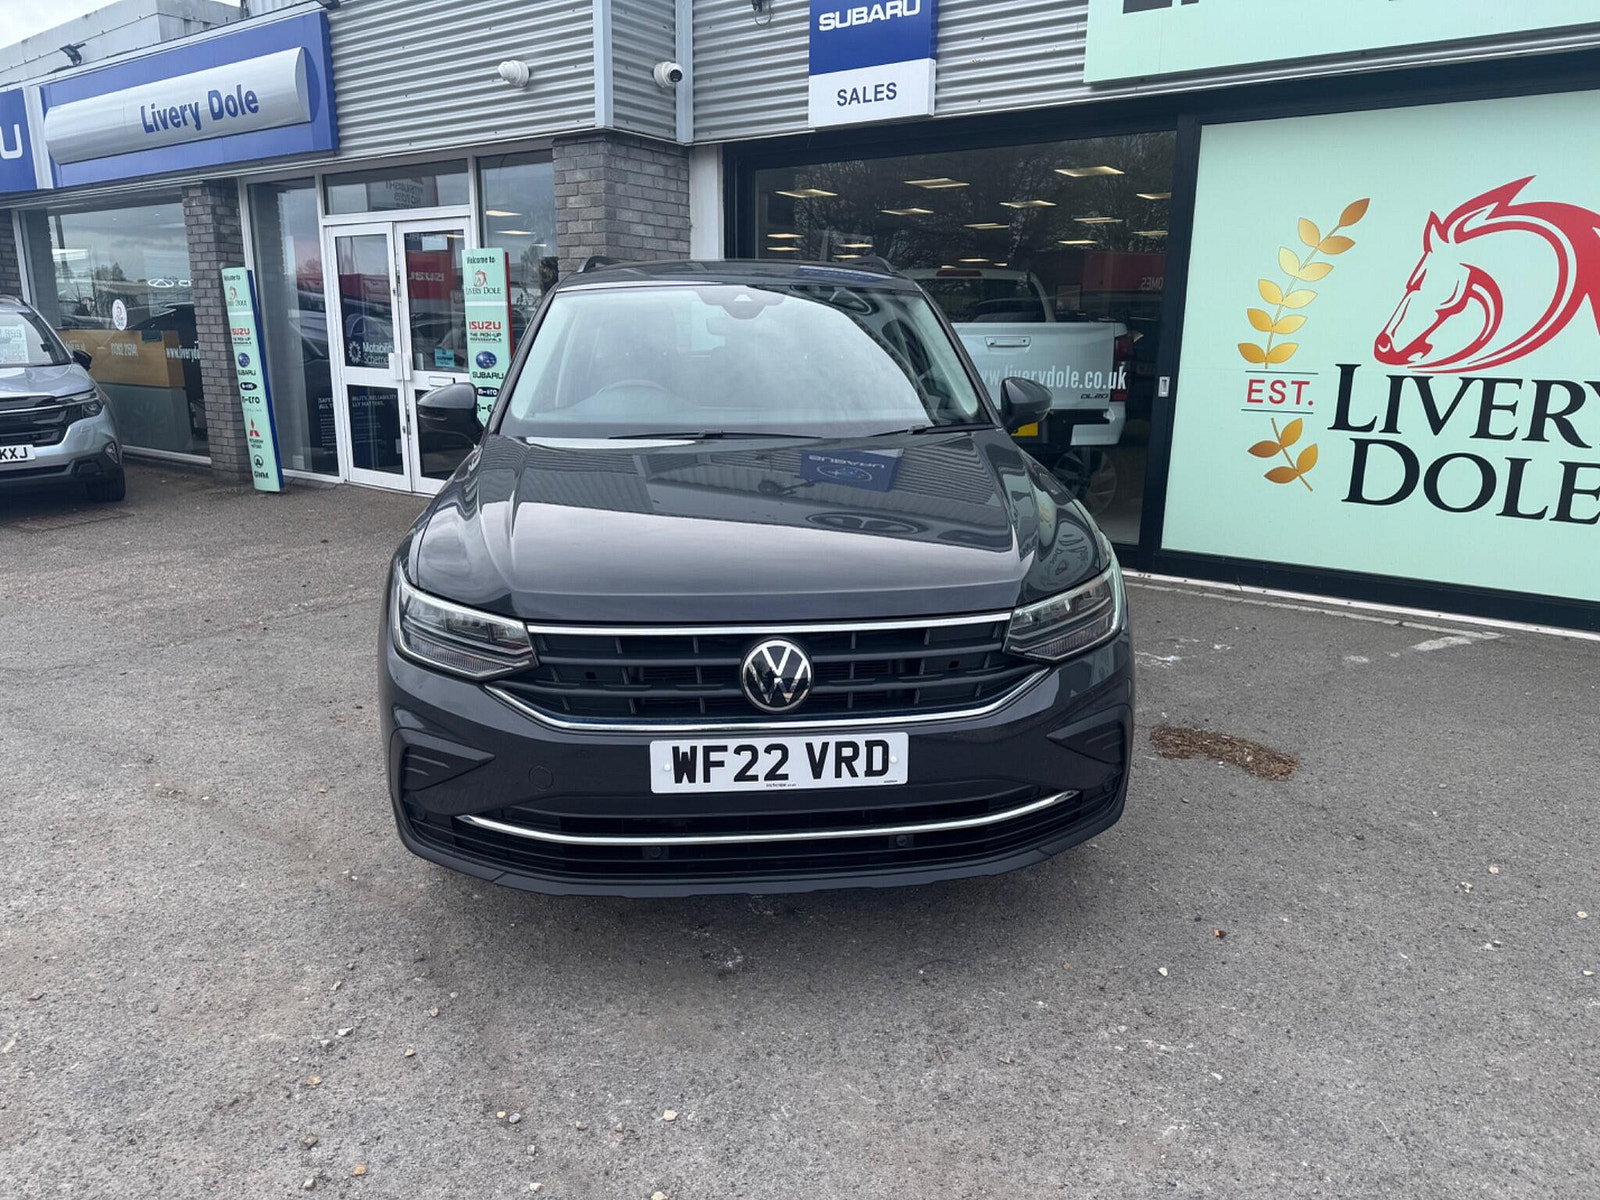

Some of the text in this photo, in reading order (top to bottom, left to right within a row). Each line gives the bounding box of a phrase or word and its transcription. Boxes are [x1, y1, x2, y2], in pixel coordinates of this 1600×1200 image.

[819, 0, 920, 31] SUBARU
[837, 82, 897, 106] SALES
[140, 84, 260, 133] Livery Dole
[469, 321, 502, 329] ISUZU
[472, 371, 504, 379] SUBARU
[1246, 379, 1314, 406] EST.
[0, 447, 28, 460] KXJ
[1341, 437, 1600, 526] DOLE
[671, 739, 890, 784] WF22 VRD
